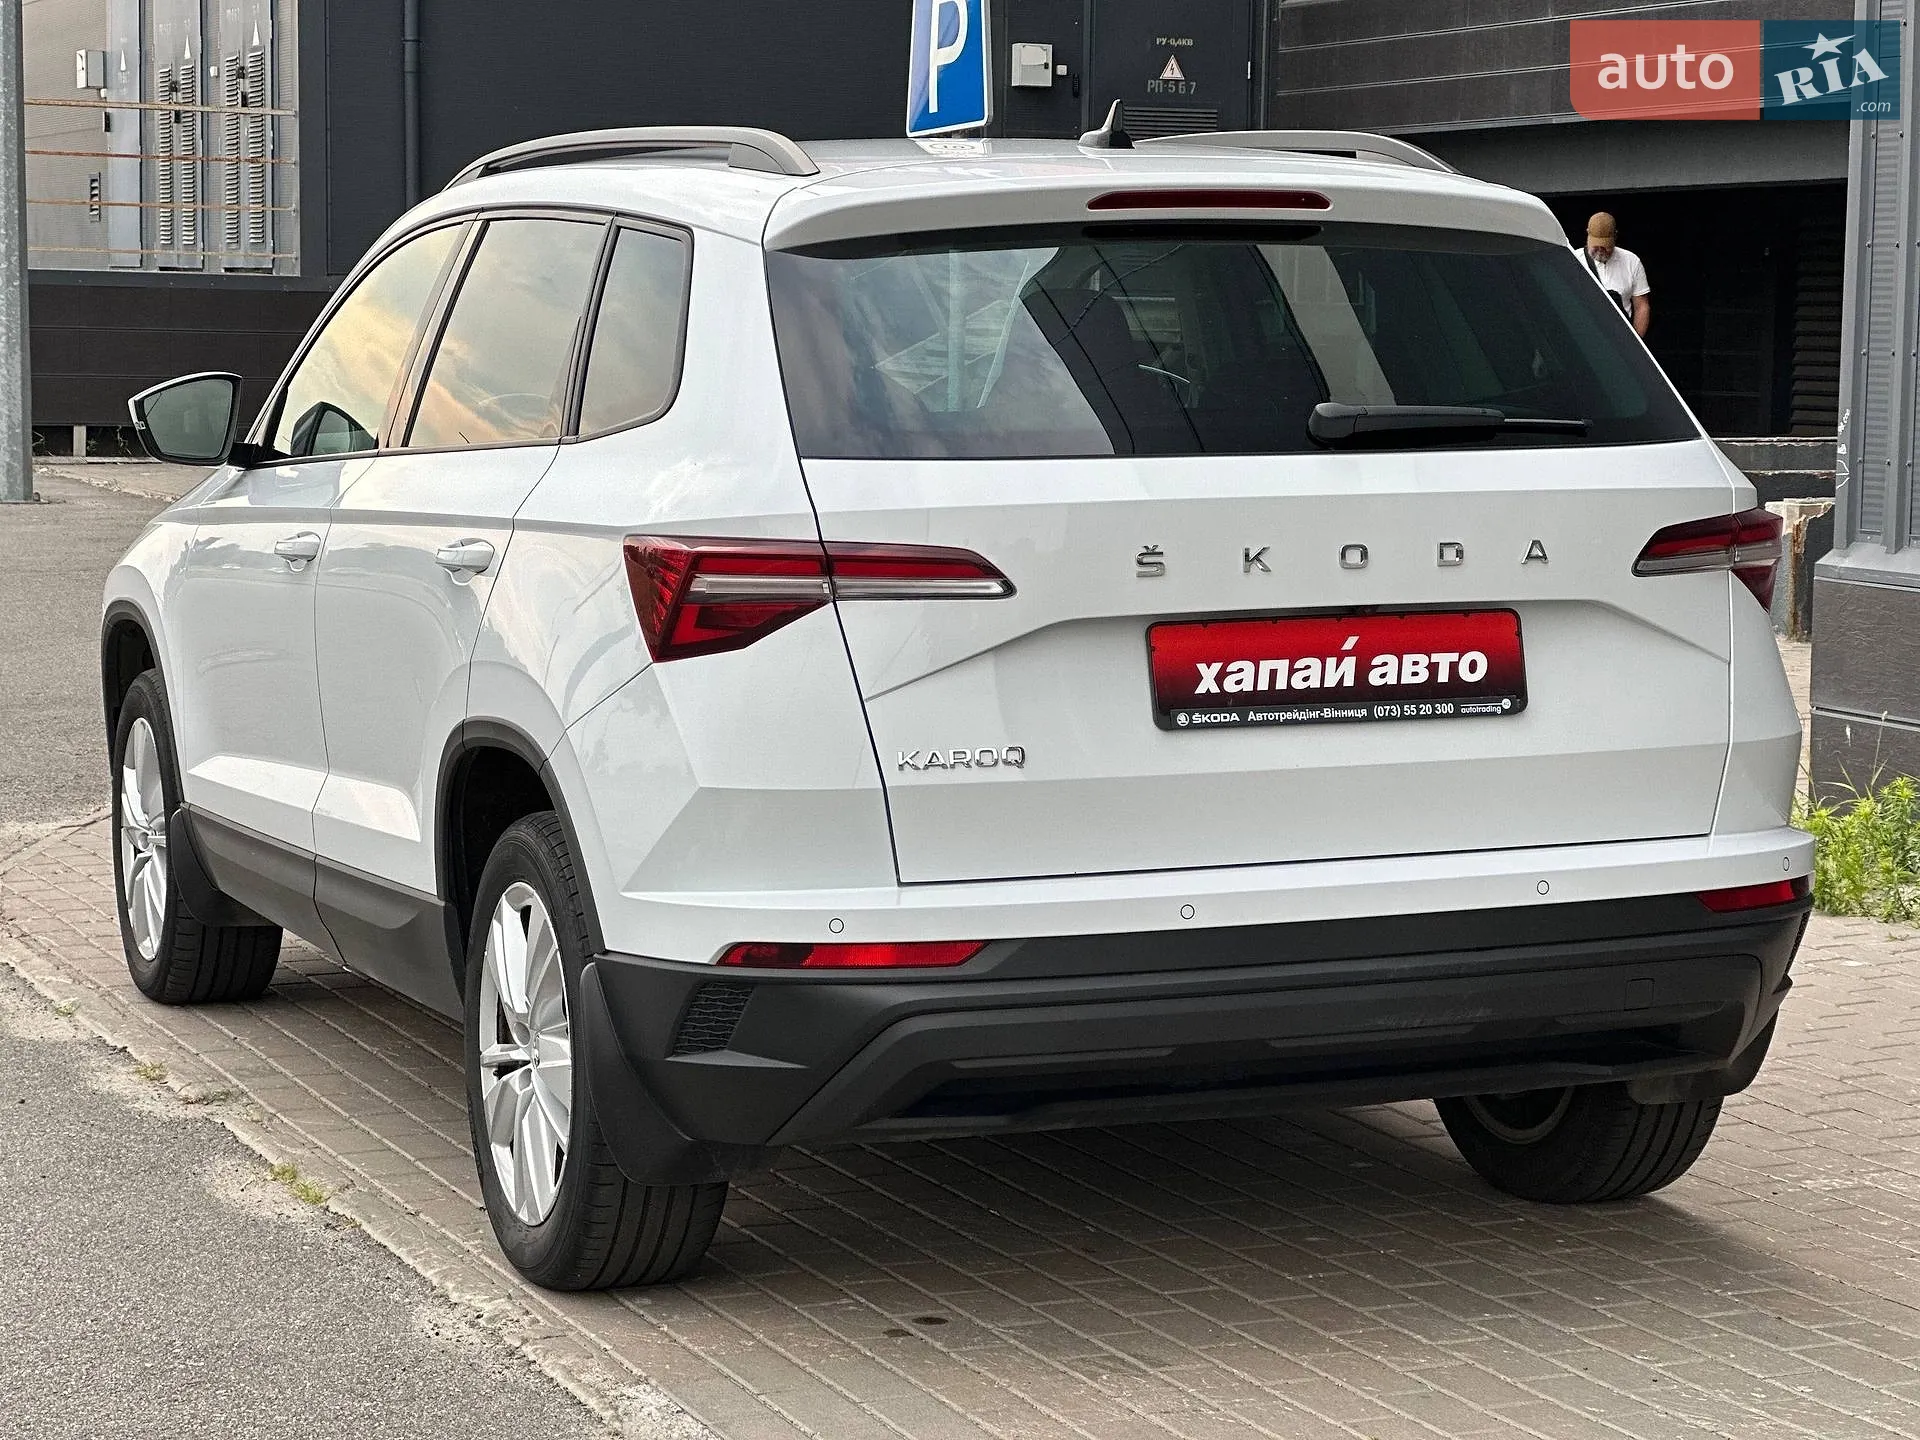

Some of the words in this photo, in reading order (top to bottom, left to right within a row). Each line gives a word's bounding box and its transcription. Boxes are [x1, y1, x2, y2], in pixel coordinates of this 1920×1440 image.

[928, 0, 968, 113] P
[1368, 651, 1489, 687] авто
[1192, 712, 1241, 723] ŠKODA
[1247, 707, 1368, 722] Автотрейдінг-Вінниця
[1373, 704, 1400, 718] (073)
[1403, 705, 1416, 716] 55
[1419, 704, 1432, 715] 20
[1434, 703, 1454, 715] 300
[1460, 706, 1502, 714] autotrading
[897, 746, 1026, 771] KAROQ
